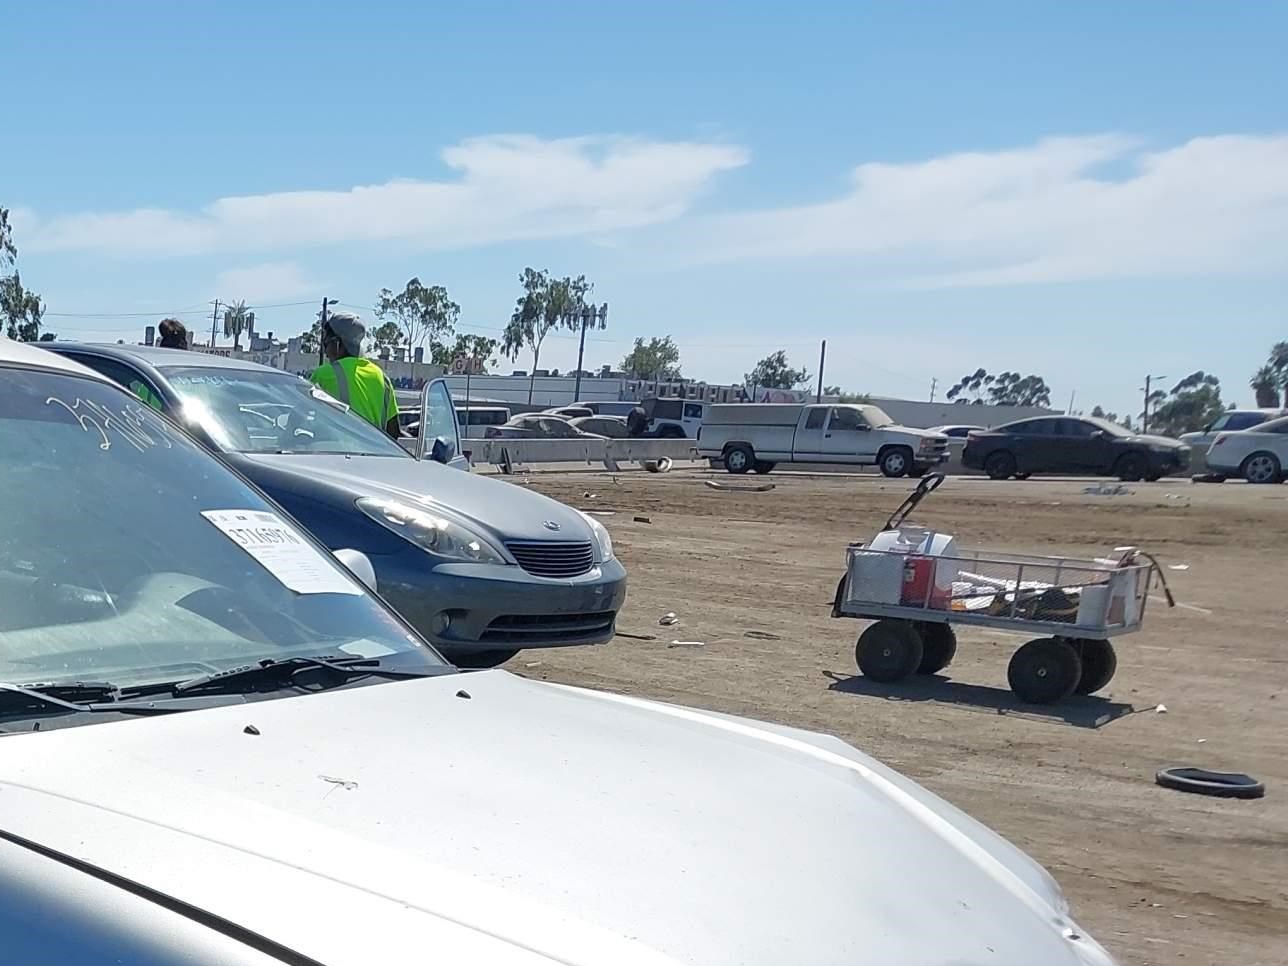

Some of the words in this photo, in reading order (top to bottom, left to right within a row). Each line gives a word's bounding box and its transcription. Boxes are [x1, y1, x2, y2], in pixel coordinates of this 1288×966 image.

[455, 359, 463, 370] G
[474, 359, 482, 370] H
[228, 527, 301, 545] 37165976
